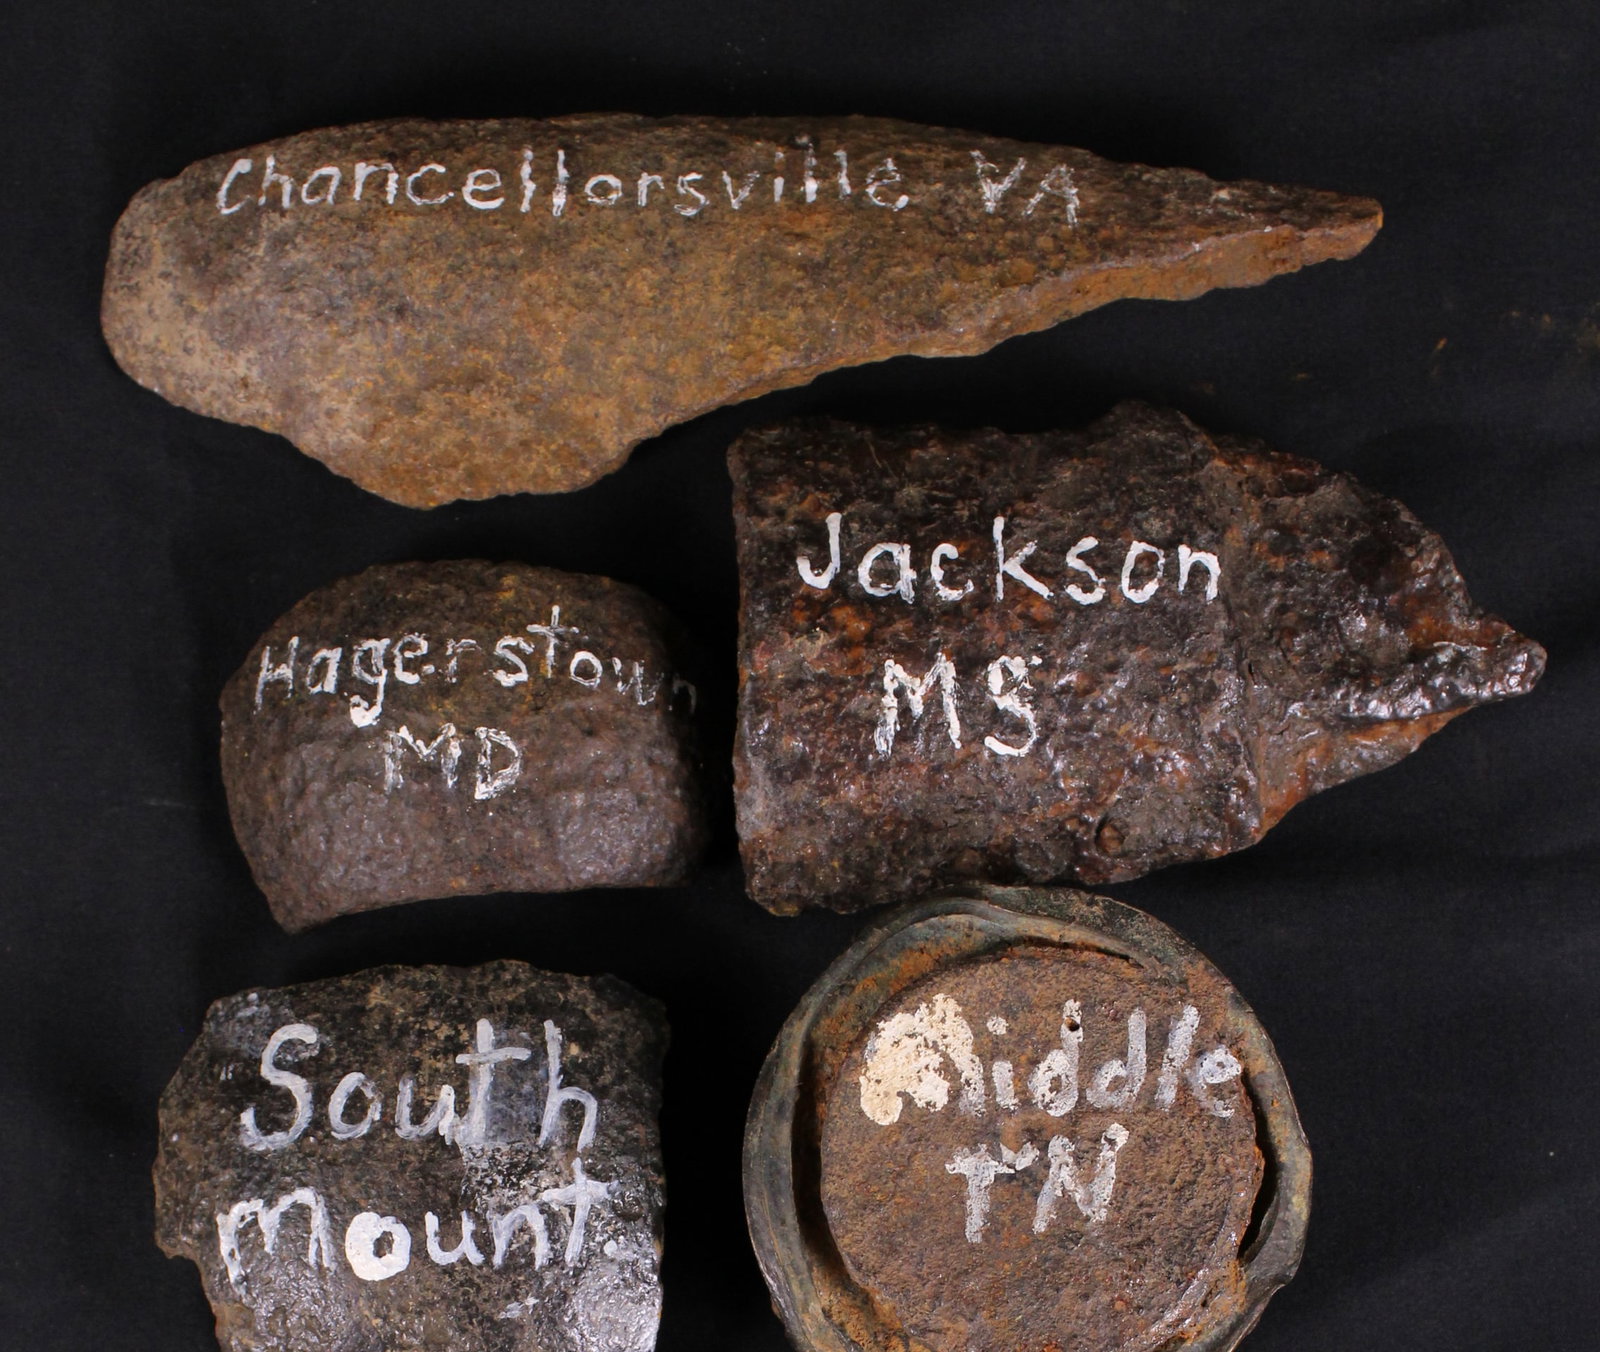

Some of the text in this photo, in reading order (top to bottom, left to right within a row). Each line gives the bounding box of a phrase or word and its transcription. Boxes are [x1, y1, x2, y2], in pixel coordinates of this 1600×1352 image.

[216, 134, 1082, 229] Chancellorsville VA
[796, 512, 1224, 606] Jackson
[873, 646, 1043, 759] MS
[383, 722, 524, 801] MD
[239, 1018, 598, 1152] South
[944, 1122, 1130, 1244] TN
